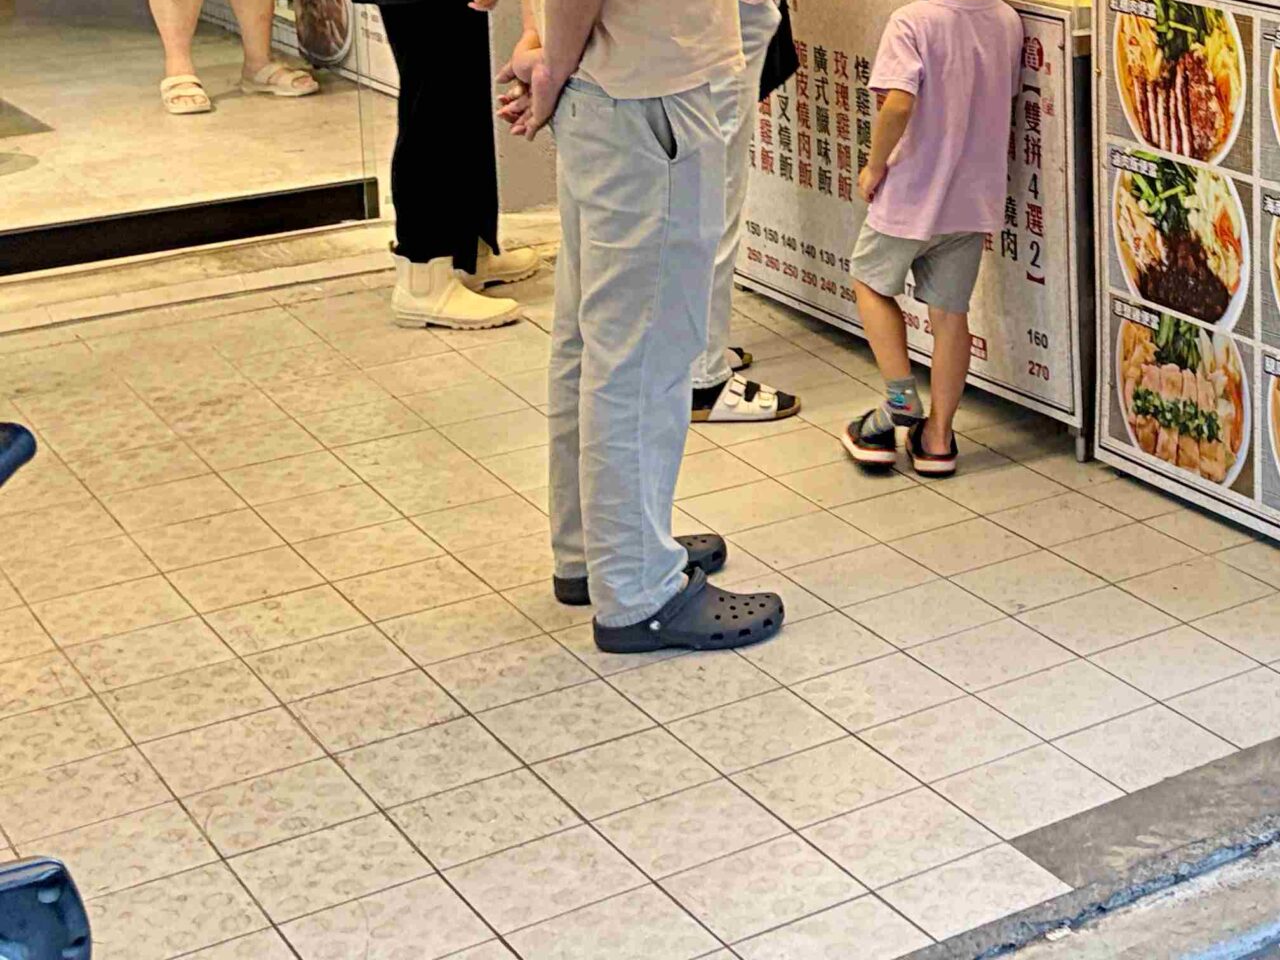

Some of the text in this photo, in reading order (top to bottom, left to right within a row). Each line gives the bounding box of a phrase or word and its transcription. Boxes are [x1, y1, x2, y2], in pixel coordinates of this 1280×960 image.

[777, 83, 794, 182] 叉燒飯
[833, 50, 853, 202] 玫瑰雞腿飯
[763, 226, 779, 244] 150
[781, 233, 797, 251] 140
[801, 242, 816, 259] 140
[819, 249, 835, 266] 130
[838, 257, 851, 272] 15
[1027, 329, 1048, 349] 160
[1028, 360, 1050, 381] 270
